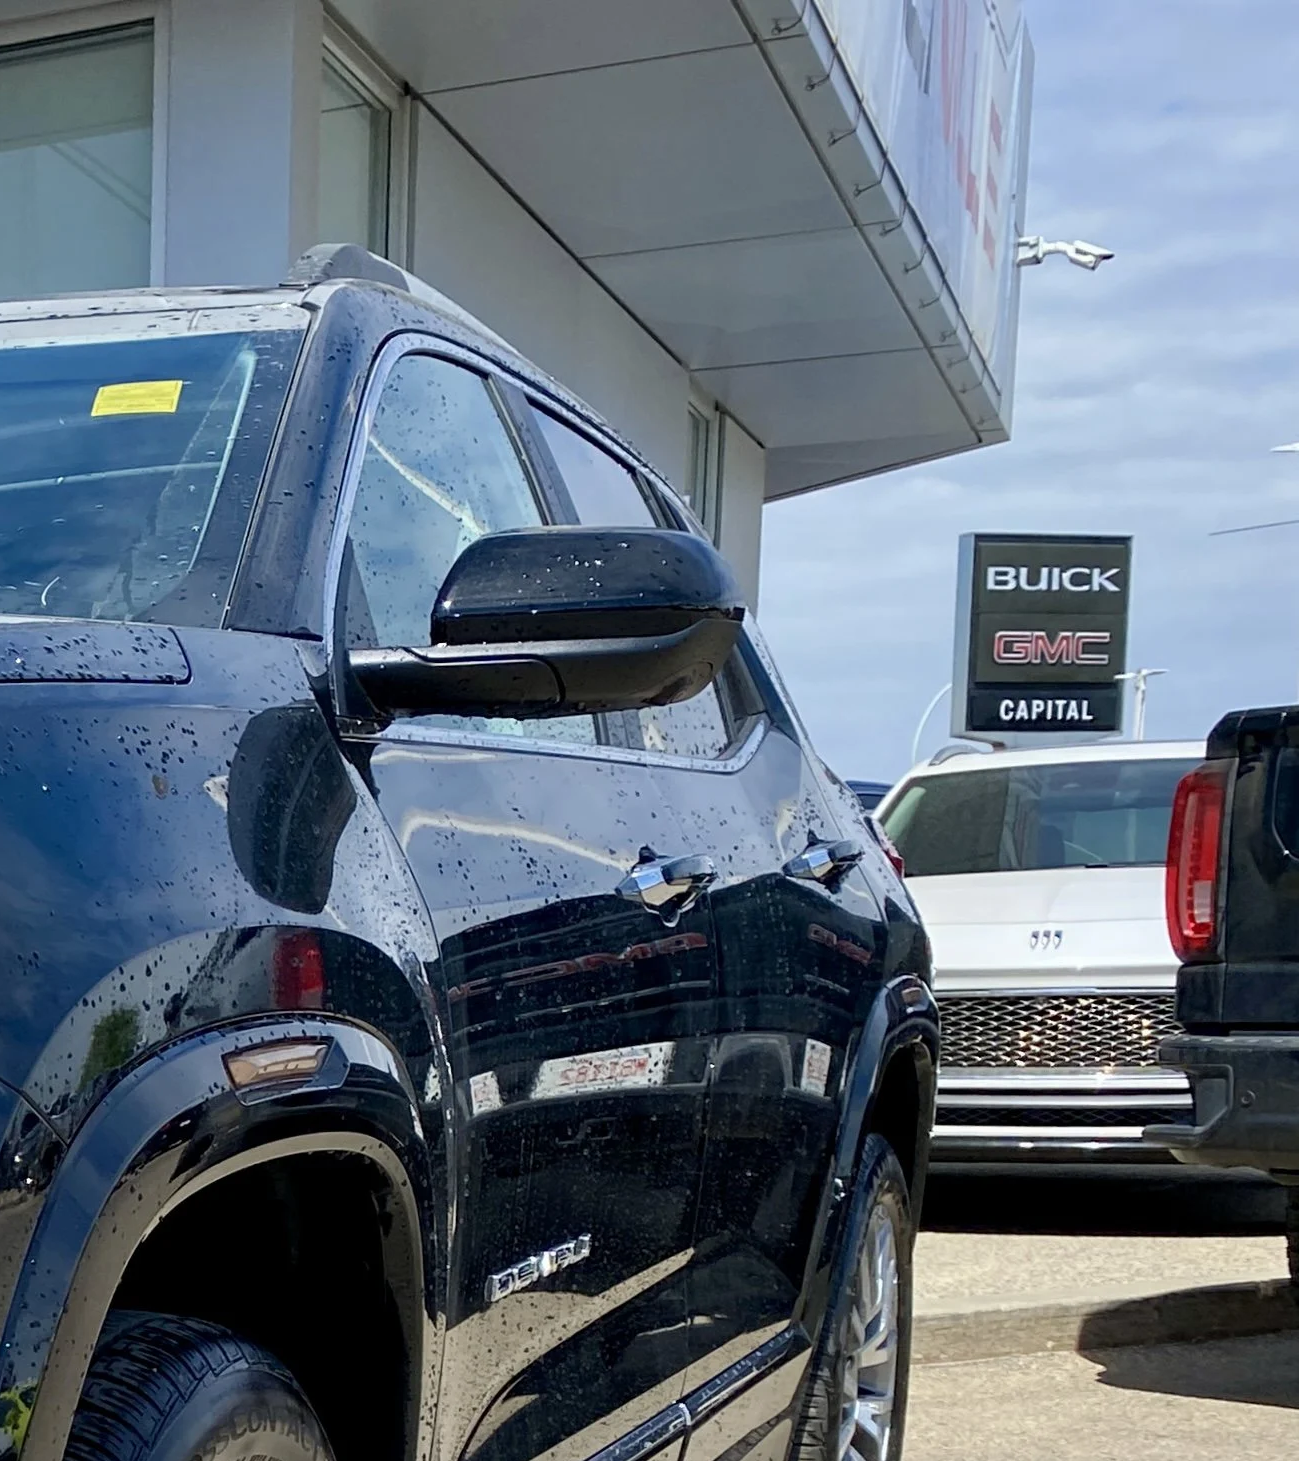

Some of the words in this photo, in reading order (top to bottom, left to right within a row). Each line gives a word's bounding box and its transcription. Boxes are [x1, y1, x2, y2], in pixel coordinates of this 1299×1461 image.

[986, 566, 1121, 591] BUICK
[994, 631, 1110, 664] GMC
[999, 699, 1093, 720] CAPITAL
